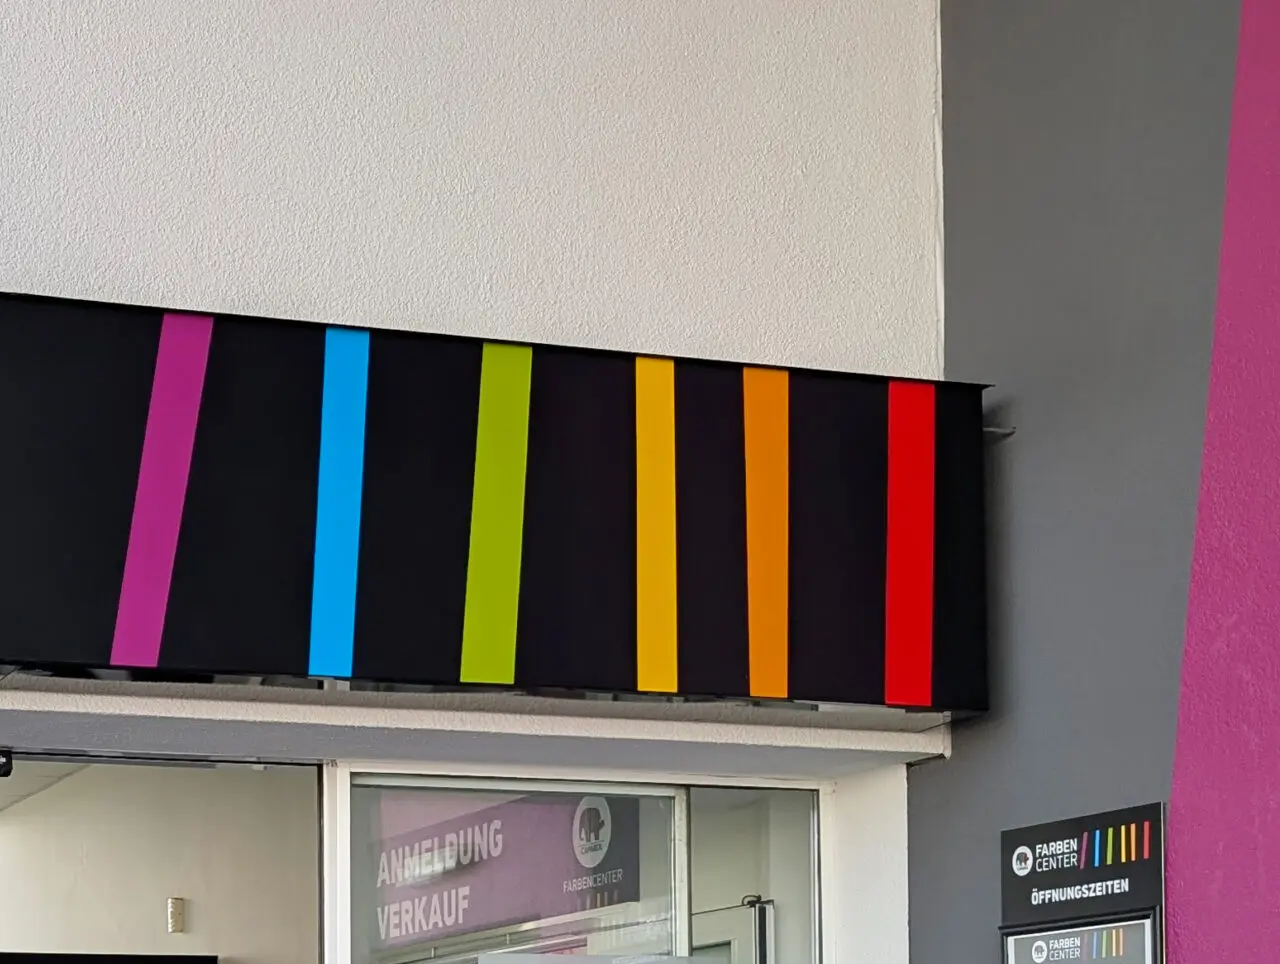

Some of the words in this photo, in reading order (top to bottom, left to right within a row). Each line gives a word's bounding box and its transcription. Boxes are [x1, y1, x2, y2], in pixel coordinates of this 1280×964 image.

[376, 820, 503, 888] ANMELDUNG
[1035, 838, 1078, 858] FARBEN
[1035, 853, 1078, 872] CENTER
[563, 868, 624, 893] FARBENCENTER
[1031, 878, 1129, 905] ÖFFNUNGSZEITEN
[377, 886, 470, 940] VERKAUF
[1049, 937, 1080, 950] FARBEN
[1049, 948, 1080, 961] CENTER
